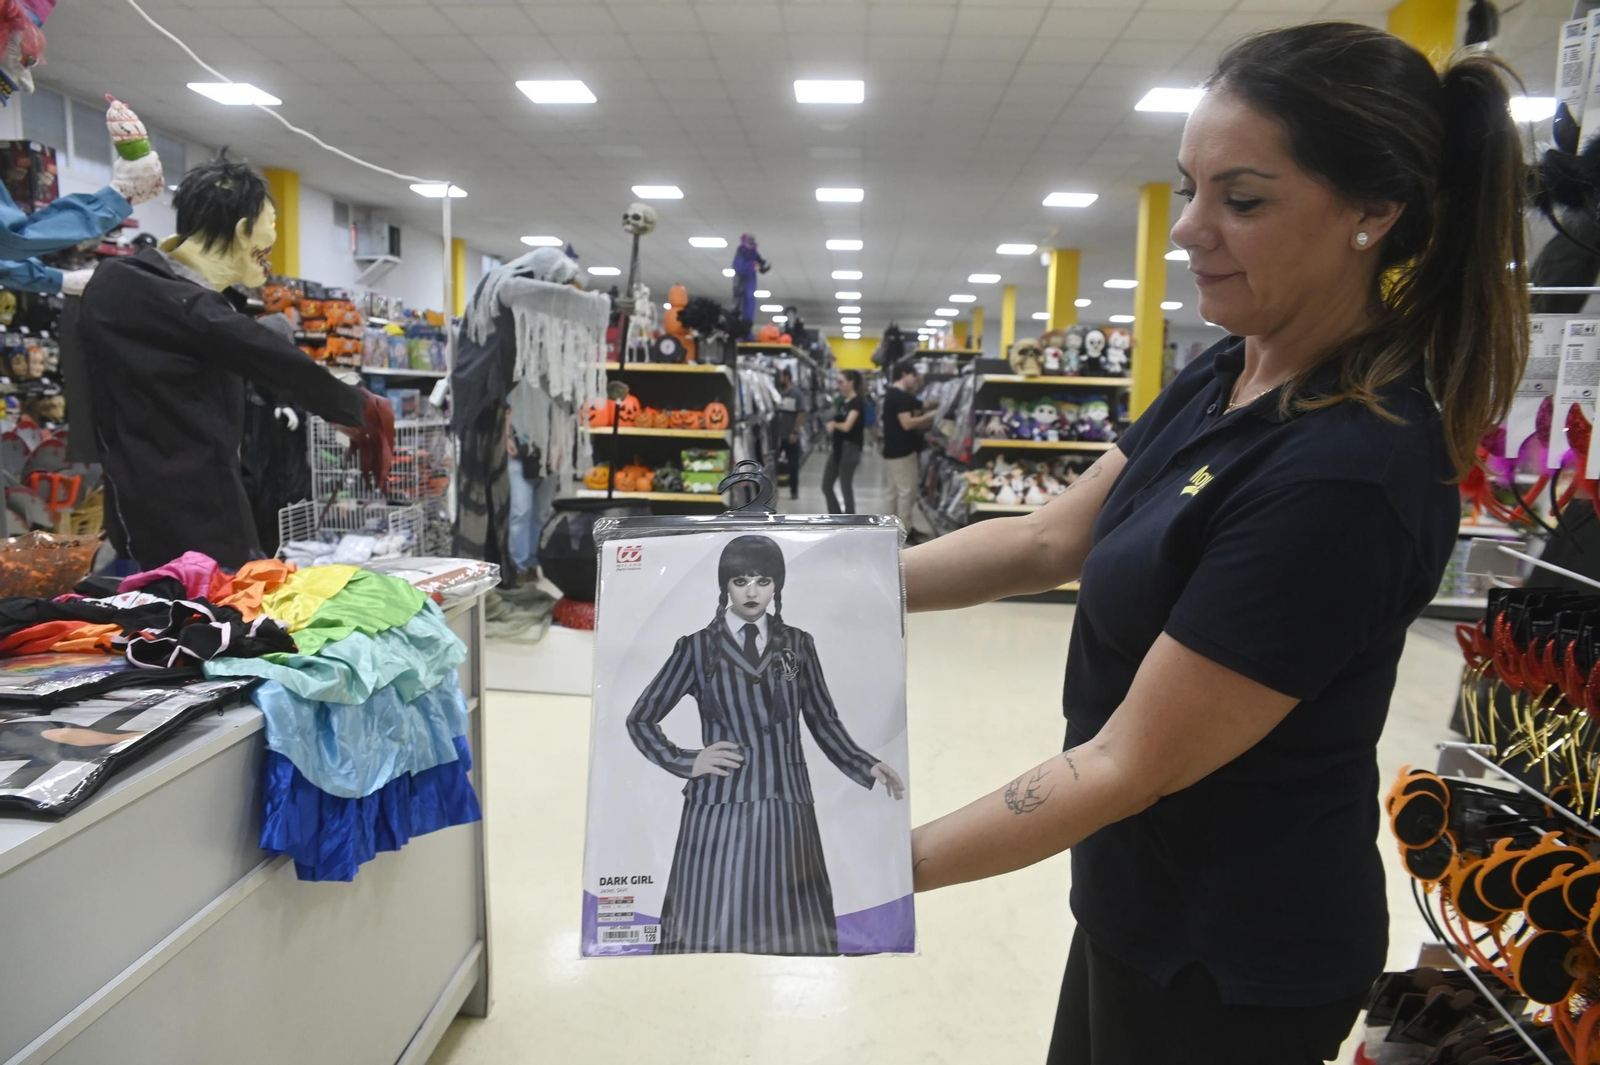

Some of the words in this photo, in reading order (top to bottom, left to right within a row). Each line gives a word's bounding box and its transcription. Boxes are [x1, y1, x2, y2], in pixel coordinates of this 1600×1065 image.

[599, 876, 629, 886] DARK
[630, 875, 654, 885] GIRL
[645, 933, 657, 942] 128
